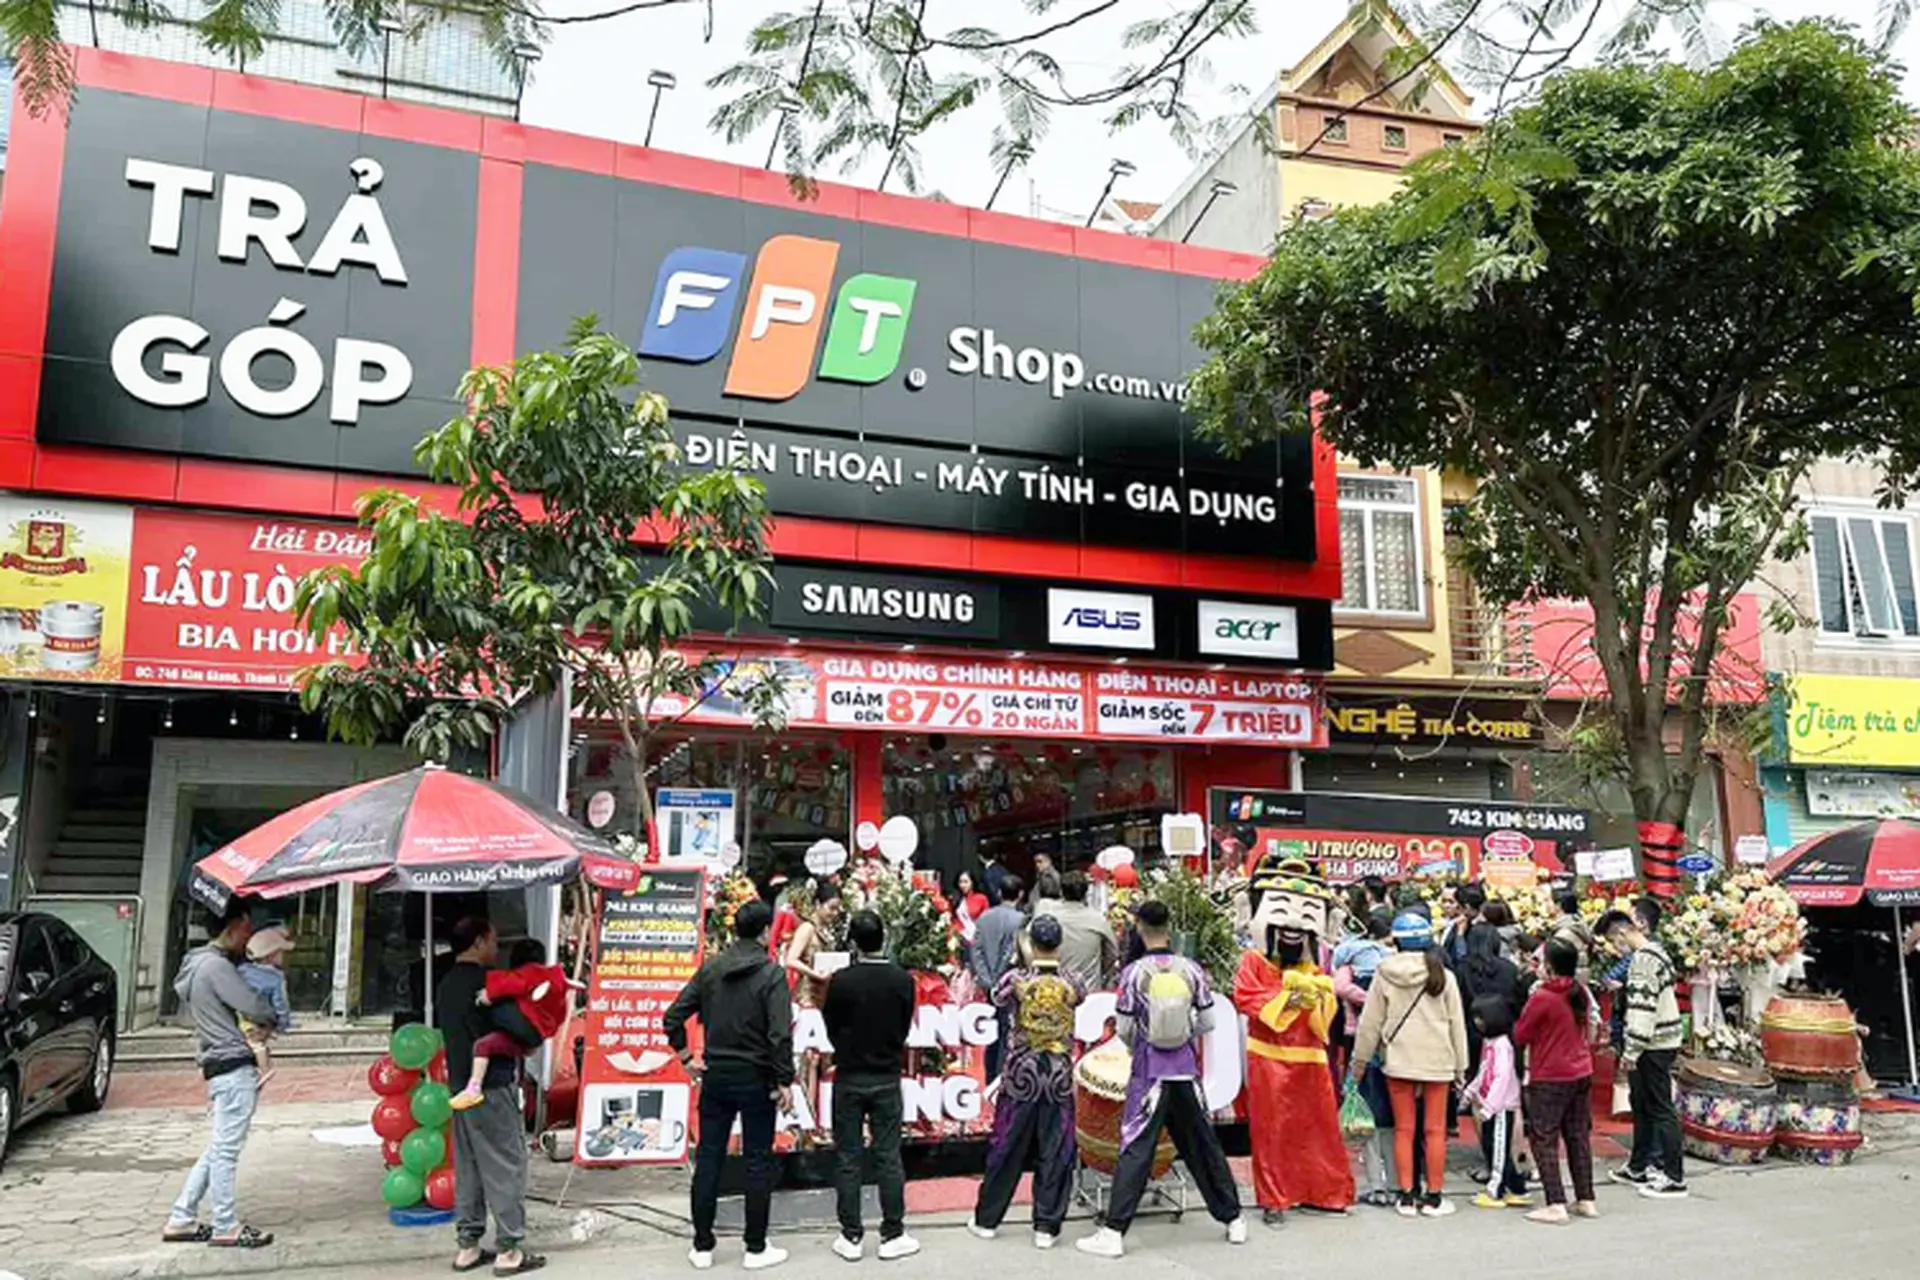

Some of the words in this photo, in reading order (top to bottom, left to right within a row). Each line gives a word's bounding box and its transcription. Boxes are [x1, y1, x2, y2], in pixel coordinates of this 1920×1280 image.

[125, 157, 406, 286] TRẢ
[110, 297, 412, 424] GÓP
[684, 430, 777, 476] ĐIỆN
[788, 444, 903, 494] THOẠI
[938, 461, 1007, 498] MÁY
[1018, 466, 1095, 506] TÍNH
[1125, 481, 1181, 514] GIA
[1189, 488, 1278, 525] DỤNG
[250, 525, 306, 550] Hải
[314, 529, 373, 554] Đăn
[142, 545, 232, 609] LẨU
[802, 583, 975, 623] SAMSUNG
[1062, 607, 1141, 631] ASUS
[1215, 618, 1281, 641] acer
[178, 623, 241, 651] BIA
[823, 659, 866, 678] GIA
[870, 661, 938, 684] DỤNG
[943, 662, 1014, 686] CHÍNH
[1018, 666, 1081, 690] HÀNG
[1098, 670, 1148, 694] ĐIỆN
[1153, 675, 1216, 700] THOẠI
[1233, 681, 1312, 700] LAPTOP
[831, 686, 882, 708] GIẢM
[886, 688, 983, 727] 87%
[854, 706, 884, 722] ĐẾN
[992, 694, 1021, 709] GIÁ
[1024, 693, 1051, 710] CHỈ
[1054, 695, 1078, 712] TỪ
[992, 712, 1018, 728] 20
[1024, 711, 1079, 731] NGÀN
[1100, 699, 1145, 720] GIẢM
[1149, 701, 1186, 721] SỐC
[1190, 703, 1216, 735] 7
[1222, 706, 1302, 740] TRIỆU
[1864, 710, 1897, 732] trà
[1448, 808, 1482, 827] 742
[1486, 810, 1522, 829] KIM
[1526, 812, 1586, 832] GIANG
[412, 869, 451, 885] GIAO
[454, 866, 498, 883] HÀNG
[605, 901, 628, 913] 742
